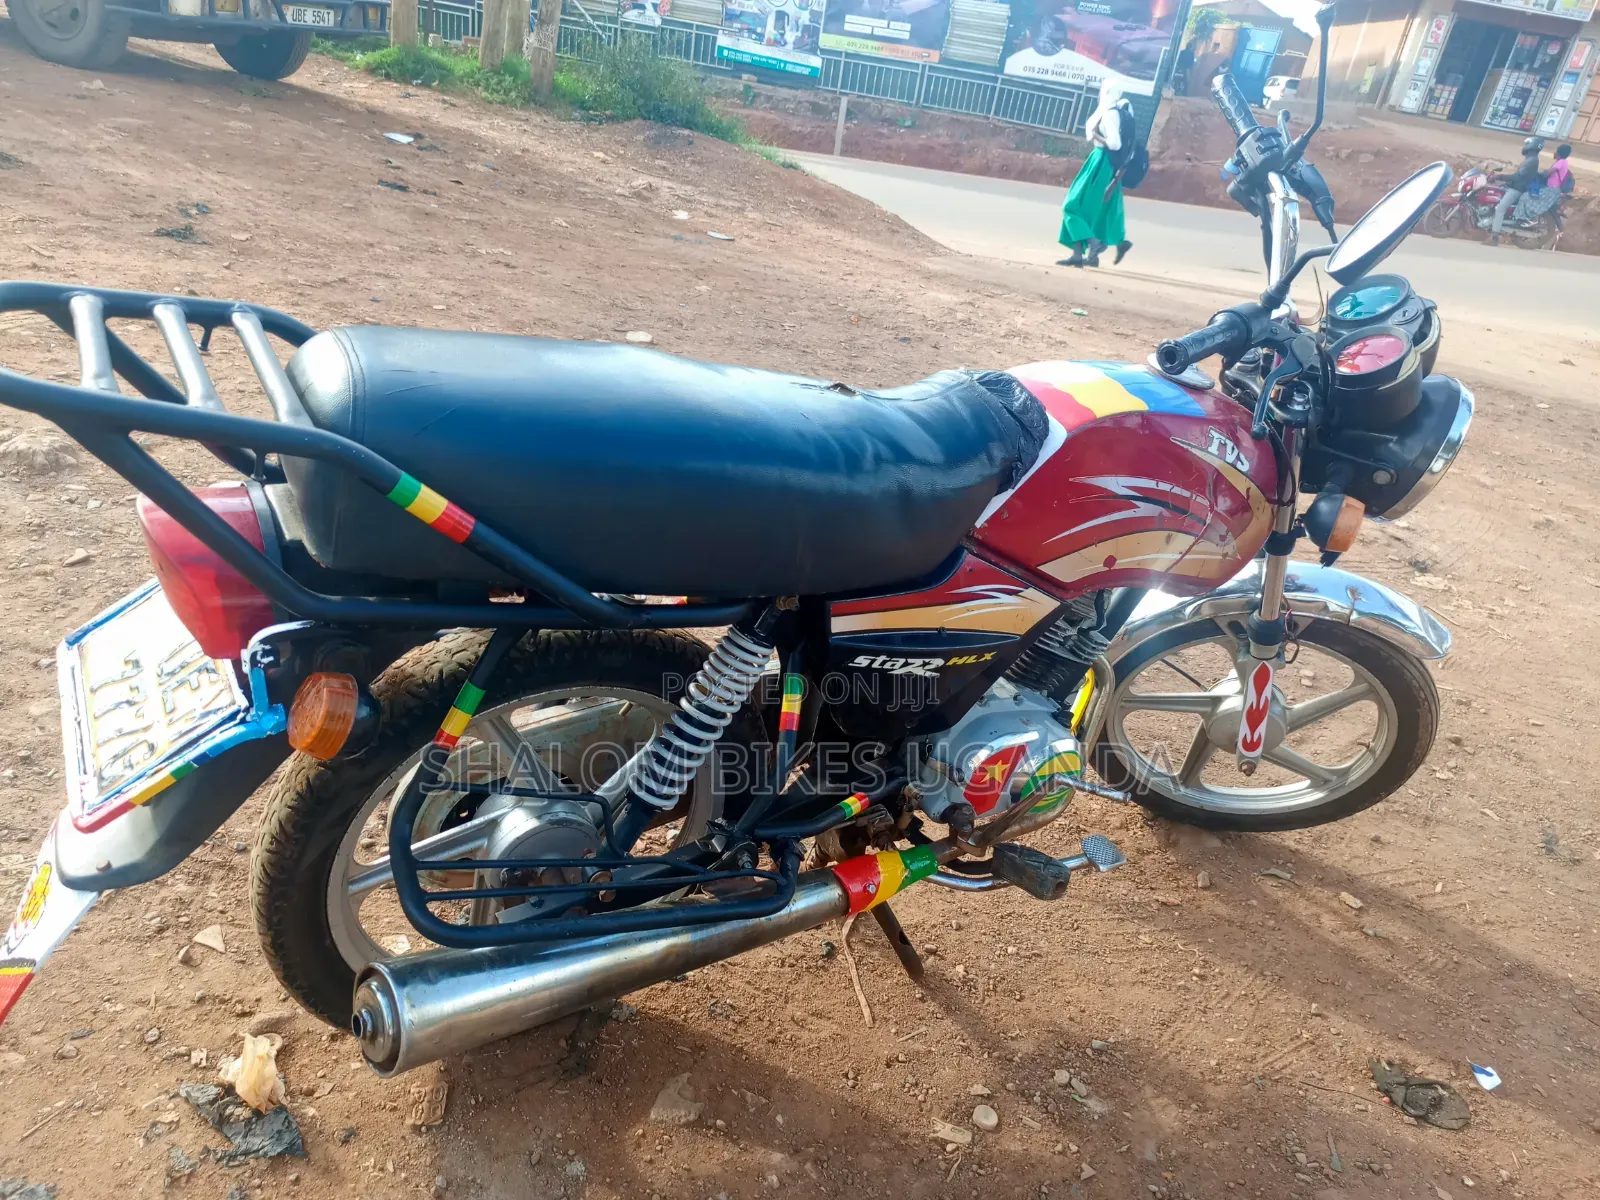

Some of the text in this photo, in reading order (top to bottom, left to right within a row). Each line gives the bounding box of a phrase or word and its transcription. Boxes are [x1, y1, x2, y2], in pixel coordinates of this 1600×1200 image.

[291, 8, 331, 25] UBE 554T
[1036, 67, 1049, 75] 228
[1207, 428, 1250, 473] TVS
[946, 651, 998, 666] HLX
